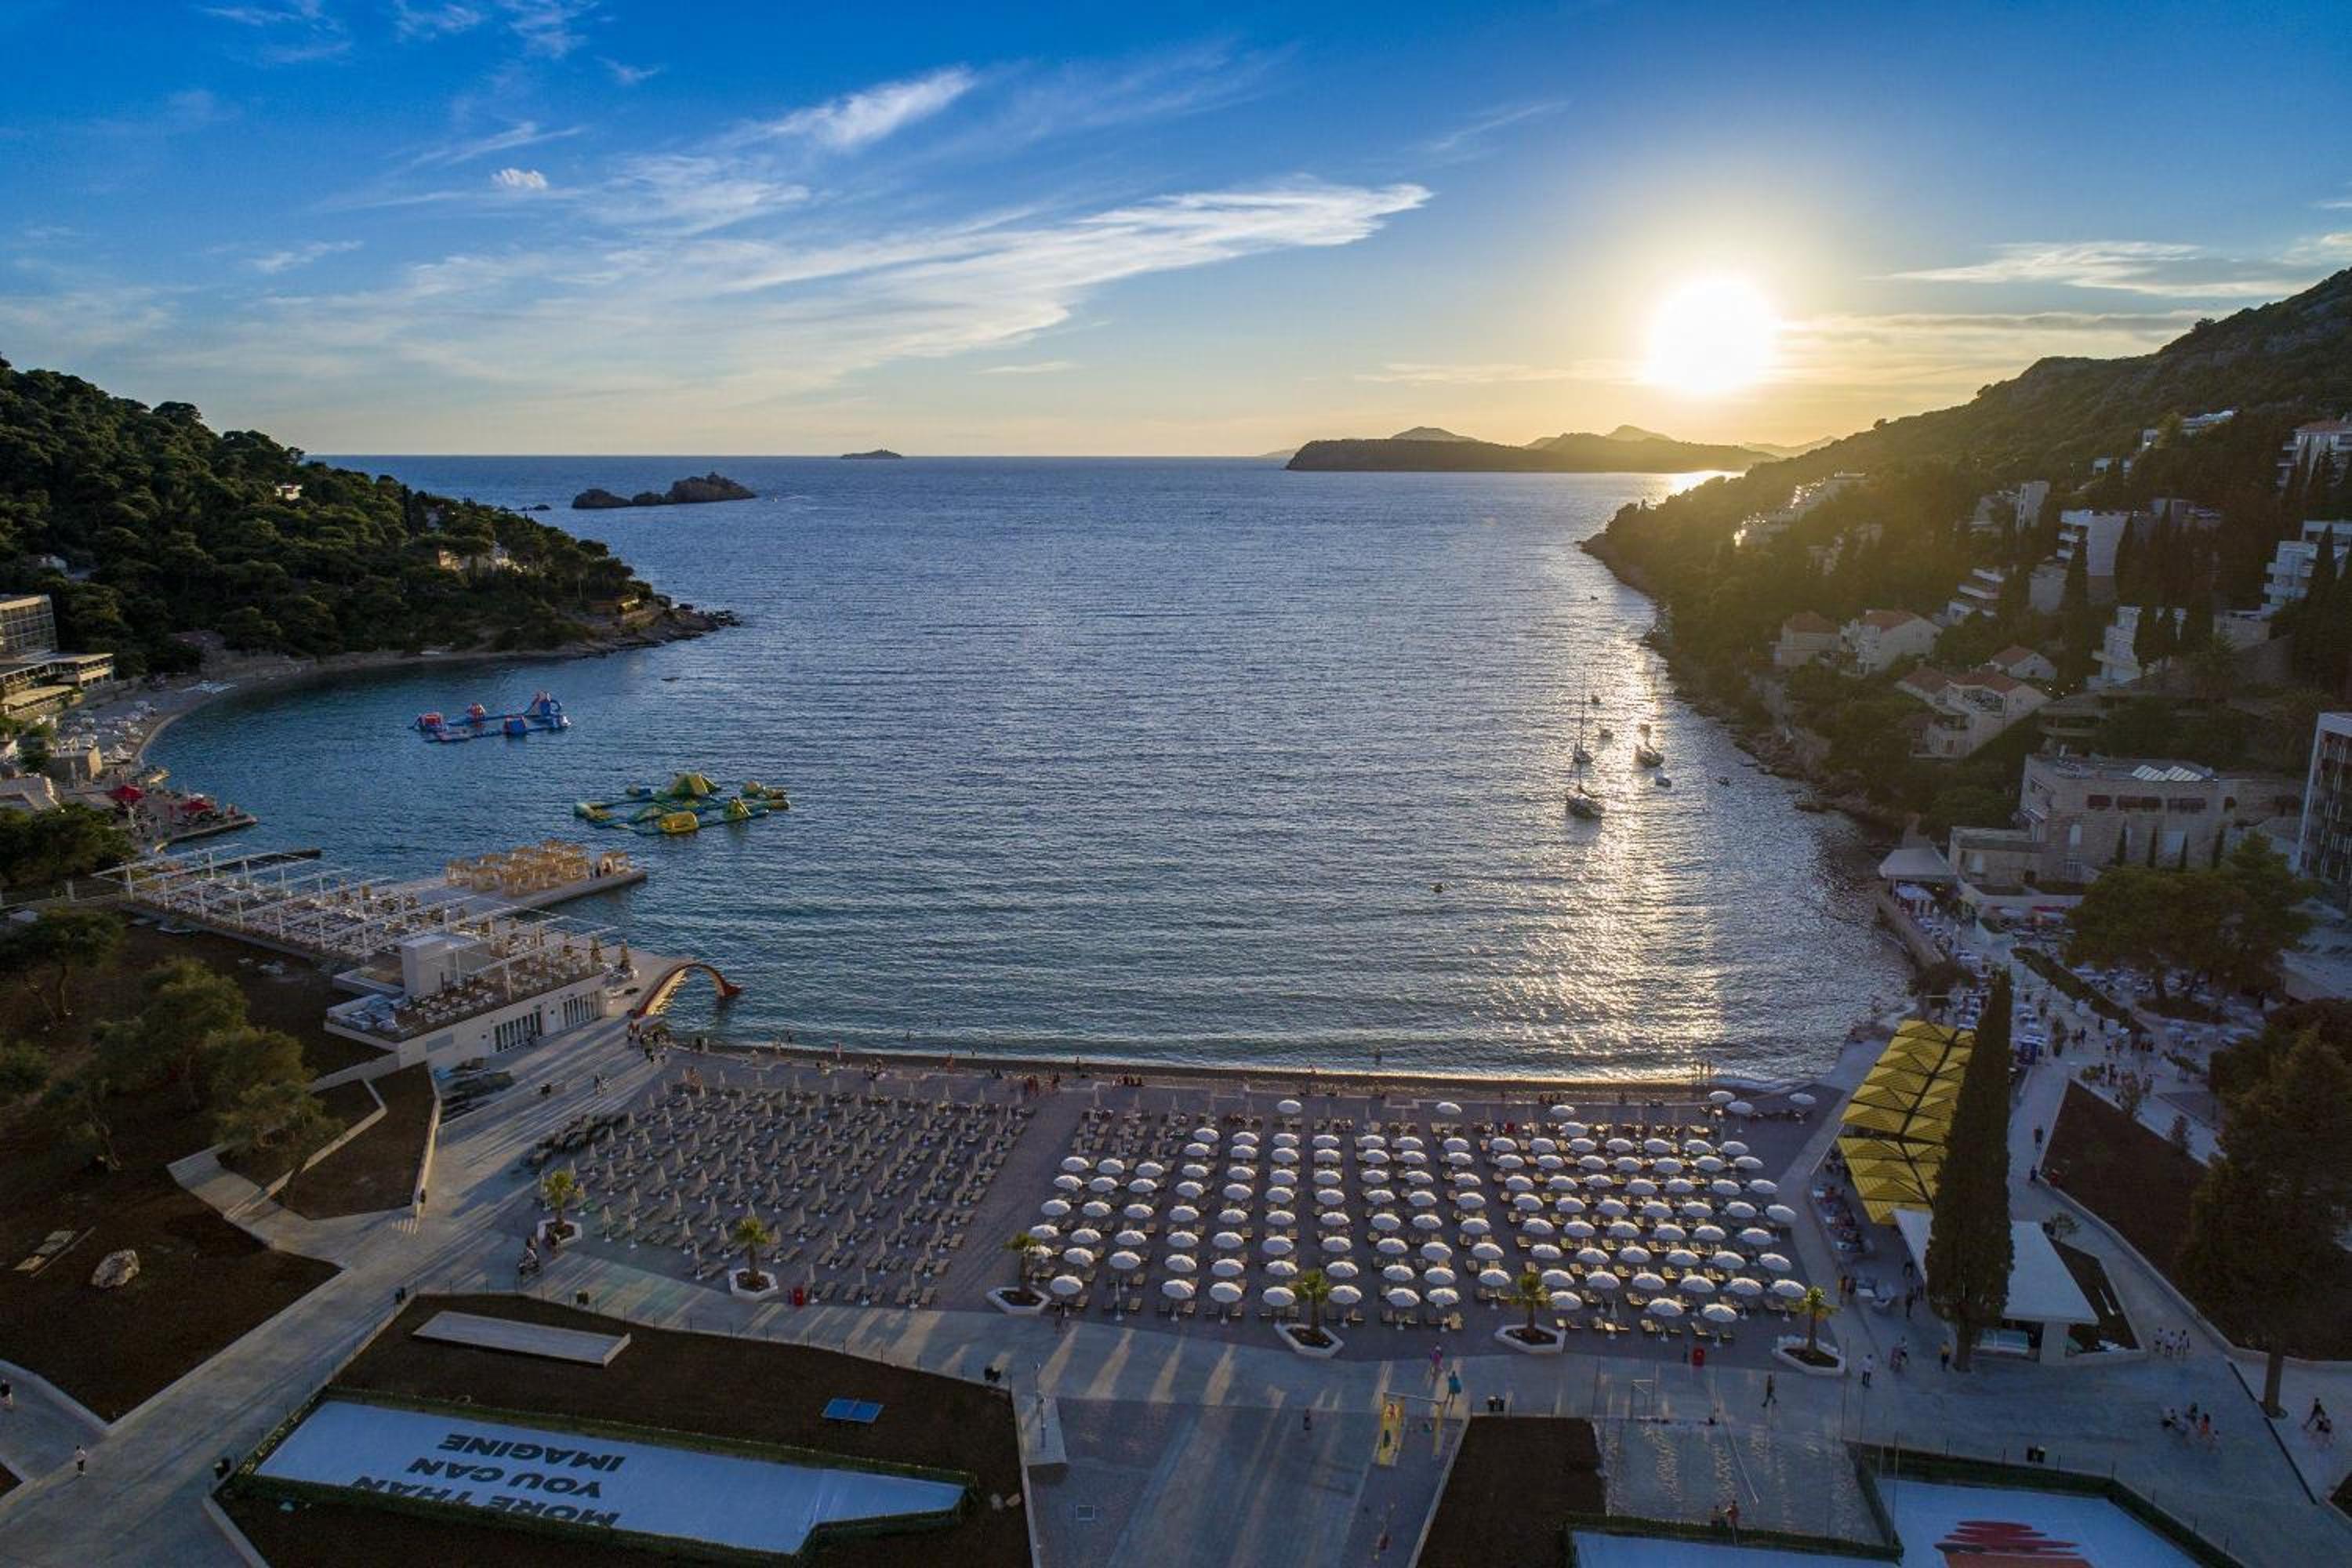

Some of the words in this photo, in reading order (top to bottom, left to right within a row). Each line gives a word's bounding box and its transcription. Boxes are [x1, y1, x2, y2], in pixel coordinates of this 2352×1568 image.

[437, 1433, 626, 1472] IMAGINE
[405, 1457, 504, 1482] CAN
[352, 1476, 473, 1505] THAN
[508, 1473, 601, 1498] YOU
[489, 1495, 620, 1526] MORE
